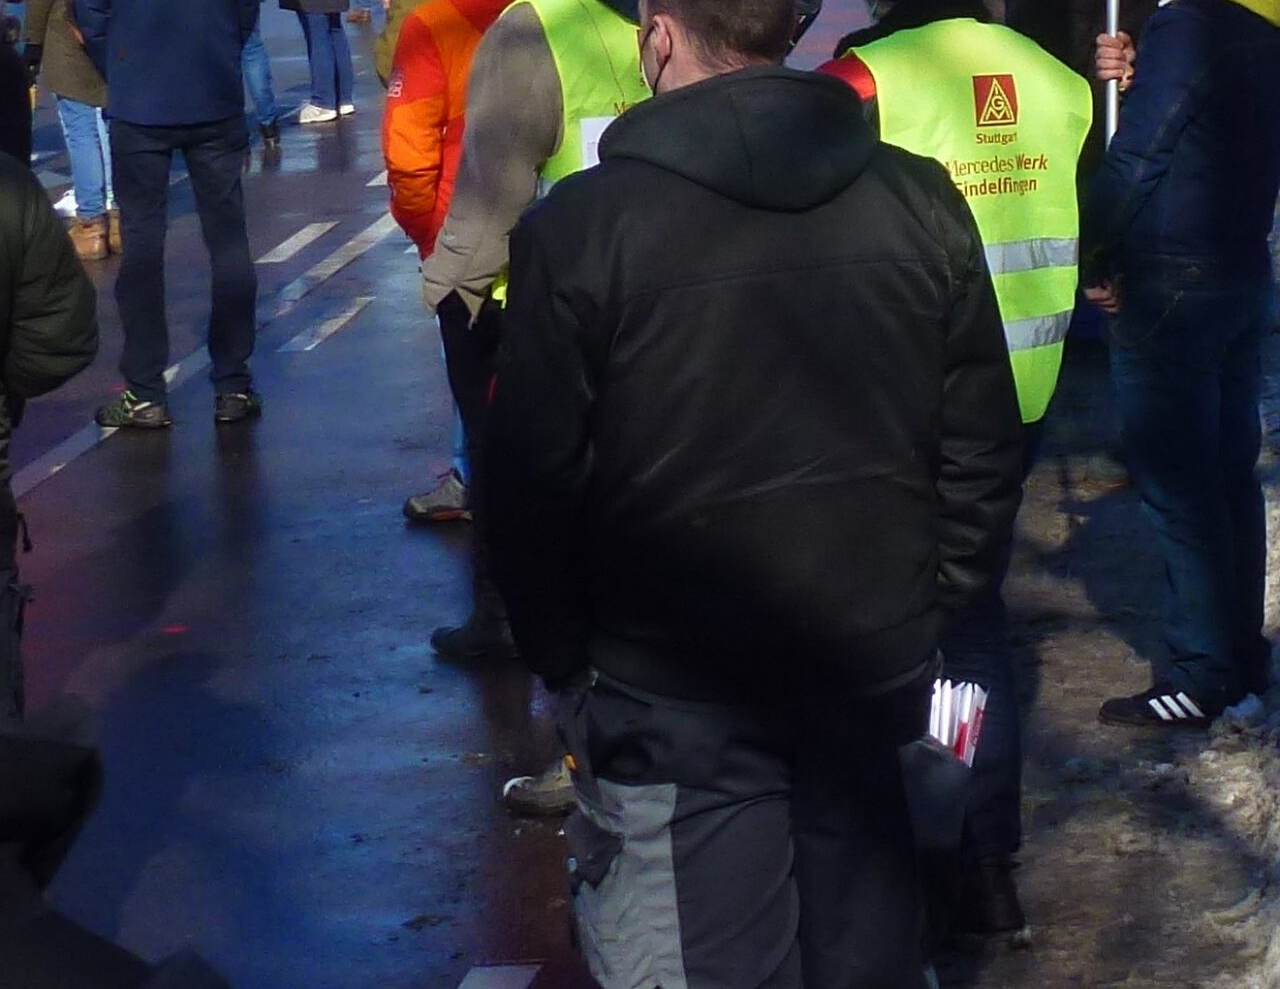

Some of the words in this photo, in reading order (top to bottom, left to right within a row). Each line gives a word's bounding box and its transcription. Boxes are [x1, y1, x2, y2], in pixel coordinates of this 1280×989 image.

[975, 131, 1018, 145] Stuttgart
[1014, 153, 1048, 171] Werk
[955, 176, 1038, 197] indelfingen
